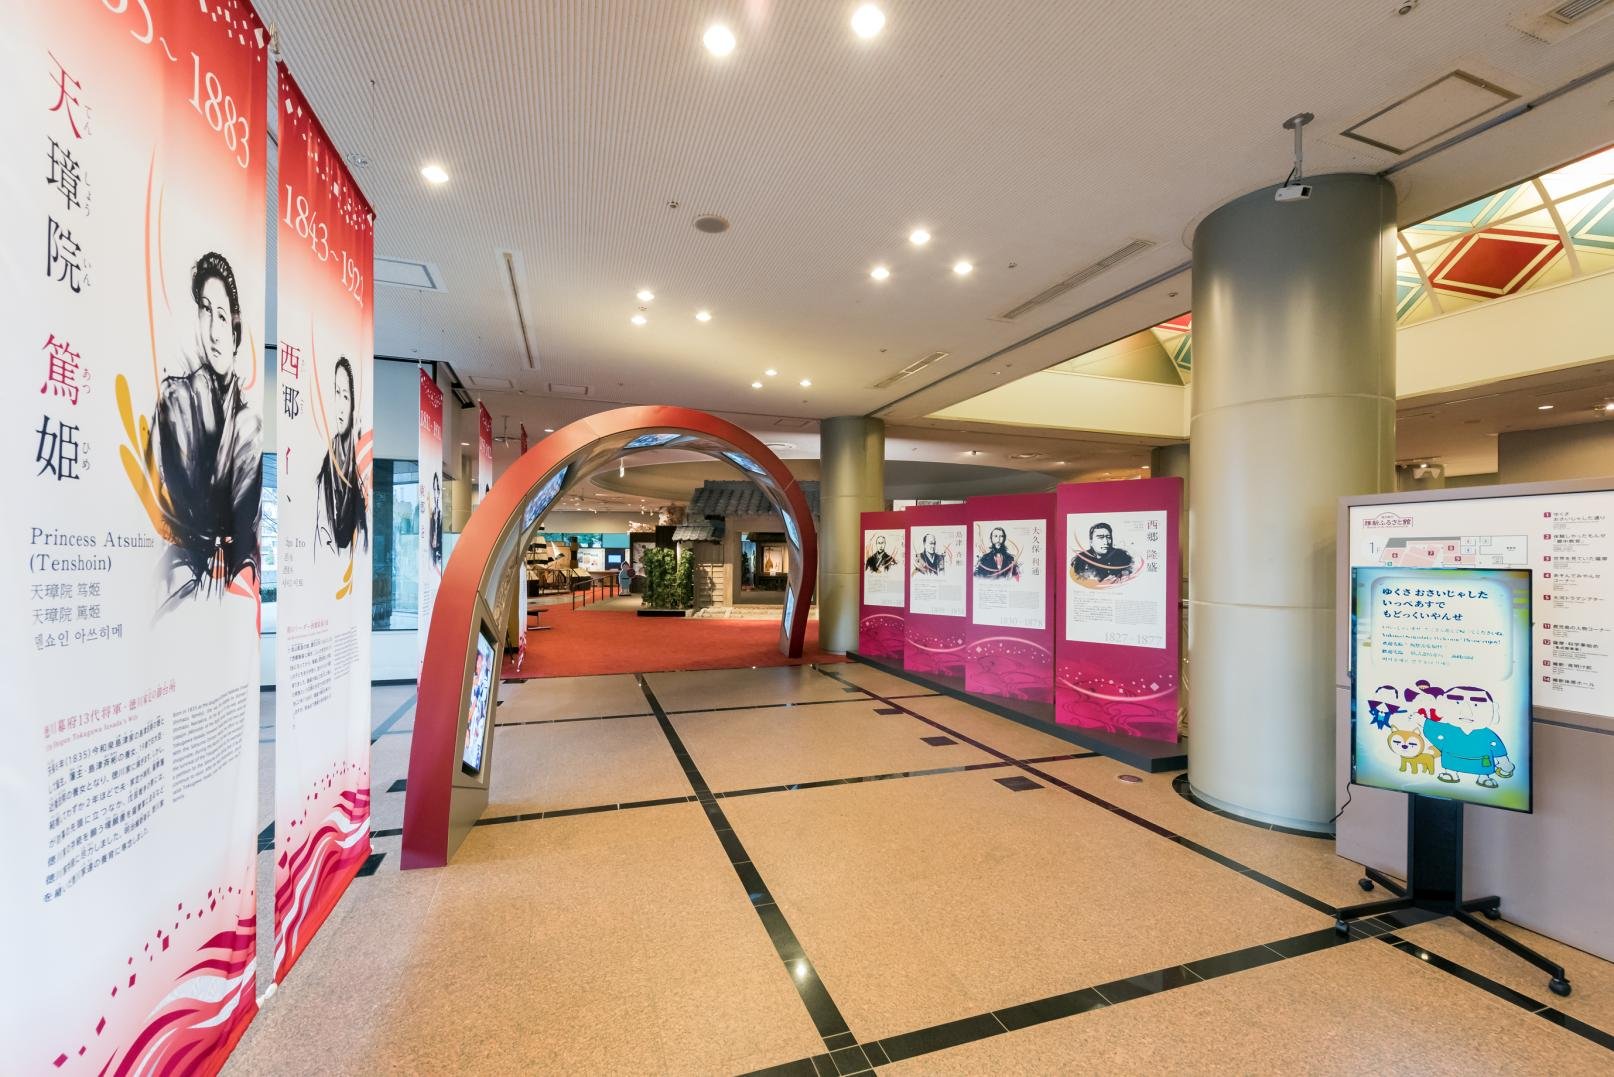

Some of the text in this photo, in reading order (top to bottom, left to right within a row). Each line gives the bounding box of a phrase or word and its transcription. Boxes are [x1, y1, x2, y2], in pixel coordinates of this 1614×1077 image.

[35, 50, 82, 482] 天璋院 篤姫
[30, 527, 96, 547] Princess
[30, 553, 112, 573] (Tenshoin)
[1382, 588, 1489, 599] ゆくさ おさいじゃした
[1383, 610, 1463, 621] もどっくいやんせ
[74, 623, 123, 643] 아쓰히메
